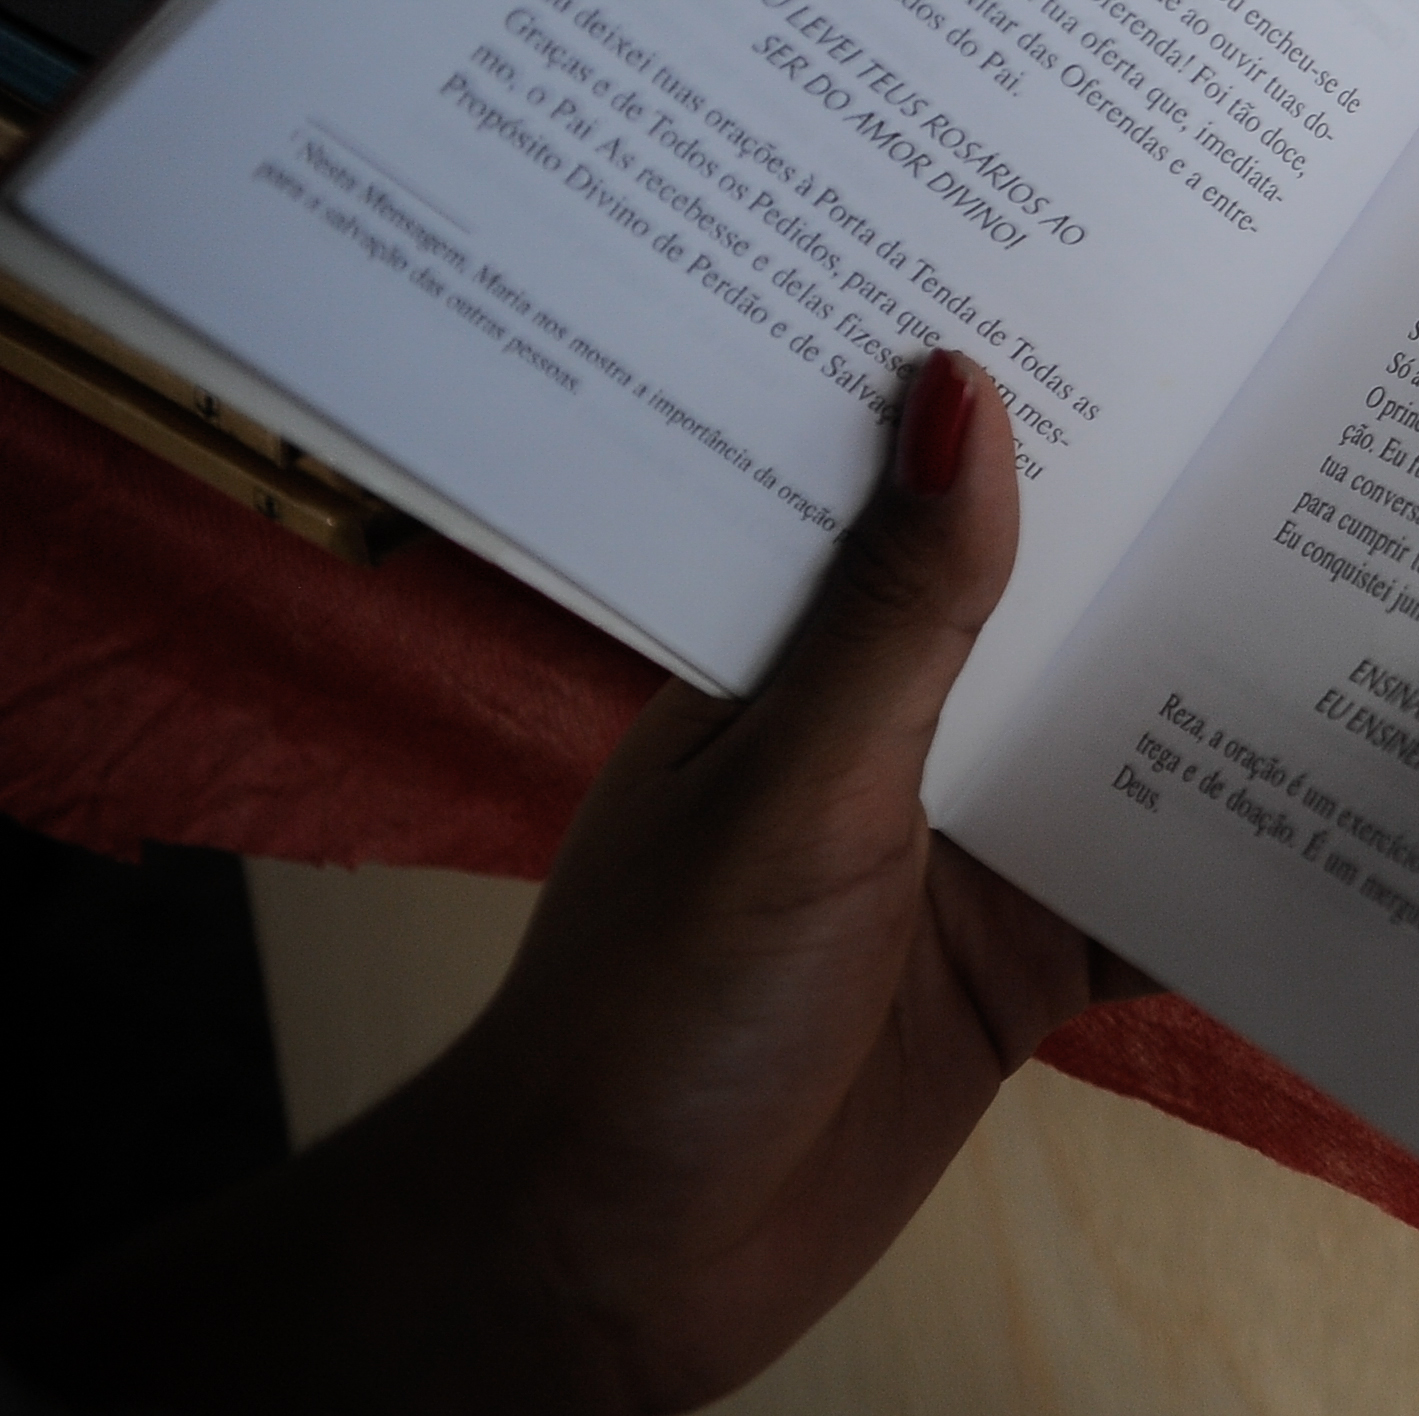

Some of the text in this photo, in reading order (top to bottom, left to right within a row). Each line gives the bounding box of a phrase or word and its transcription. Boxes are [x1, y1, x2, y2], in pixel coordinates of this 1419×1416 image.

[751, 35, 1028, 250] SER DO AMOR DIVINO!
[784, 4, 864, 64] LEVEI
[855, 58, 930, 117] TEUS
[918, 112, 1050, 215] ROSÁRIOS
[1037, 214, 1086, 245] AO
